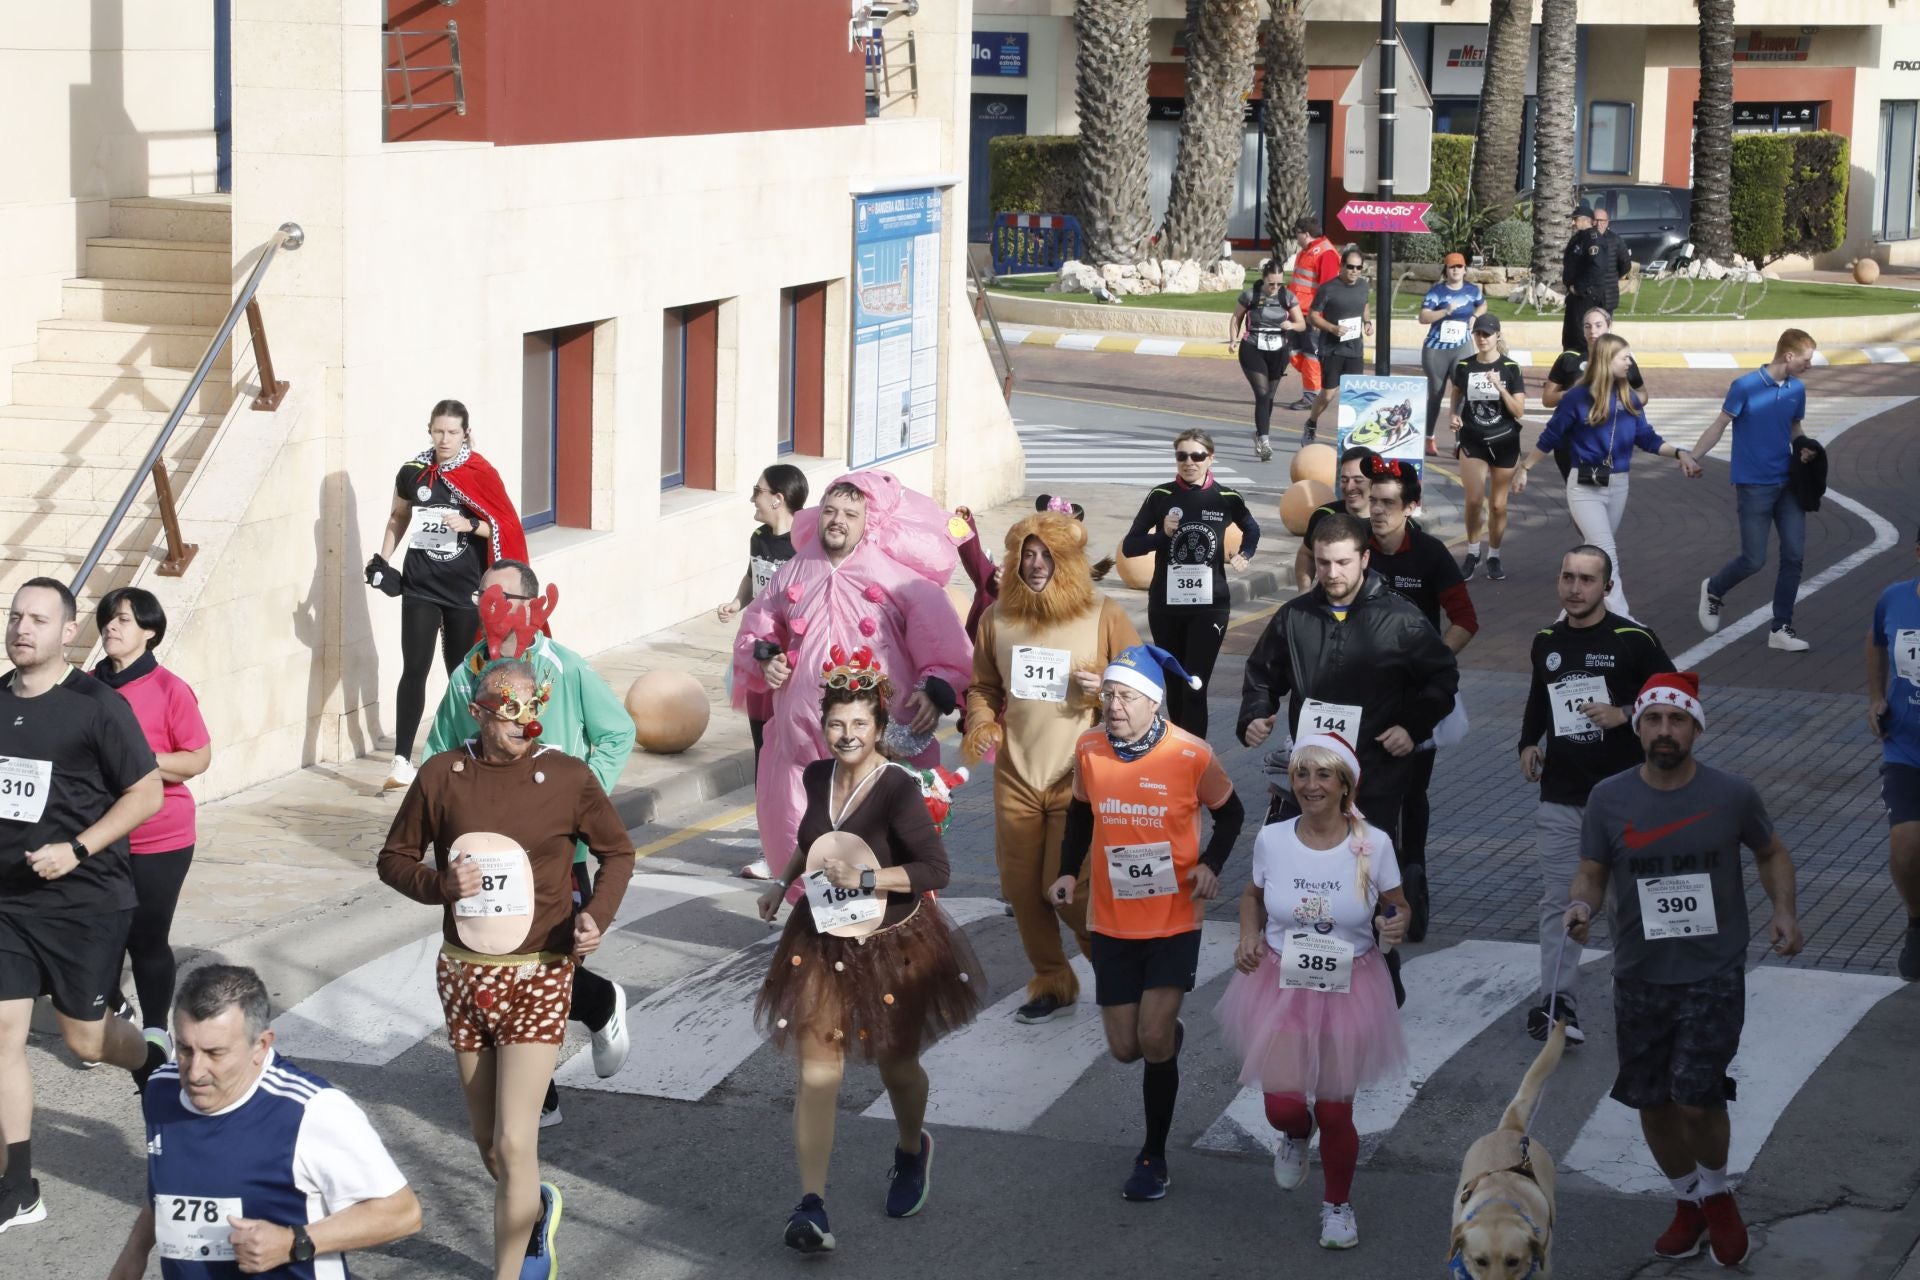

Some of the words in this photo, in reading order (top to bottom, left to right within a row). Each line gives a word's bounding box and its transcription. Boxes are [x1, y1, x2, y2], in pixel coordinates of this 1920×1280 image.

[1345, 205, 1412, 216] MAREMOTO
[1353, 219, 1375, 230] Jet
[1344, 380, 1419, 393] MAREMOTO
[1475, 382, 1493, 390] 235
[422, 522, 448, 534] 225
[1177, 578, 1202, 589] 384
[1024, 665, 1054, 680] 311
[1314, 716, 1345, 732] 144
[2, 779, 35, 797] 310
[1099, 798, 1168, 817] villamor
[1132, 816, 1164, 828] HOTEL
[1628, 856, 1665, 874] JUST
[1672, 854, 1697, 871] DO
[1704, 851, 1720, 869] IT
[1129, 863, 1153, 878] 64
[1294, 878, 1342, 891] Flowers
[1657, 896, 1697, 913] 390
[1298, 954, 1337, 971] 385
[172, 1198, 218, 1223] 278
